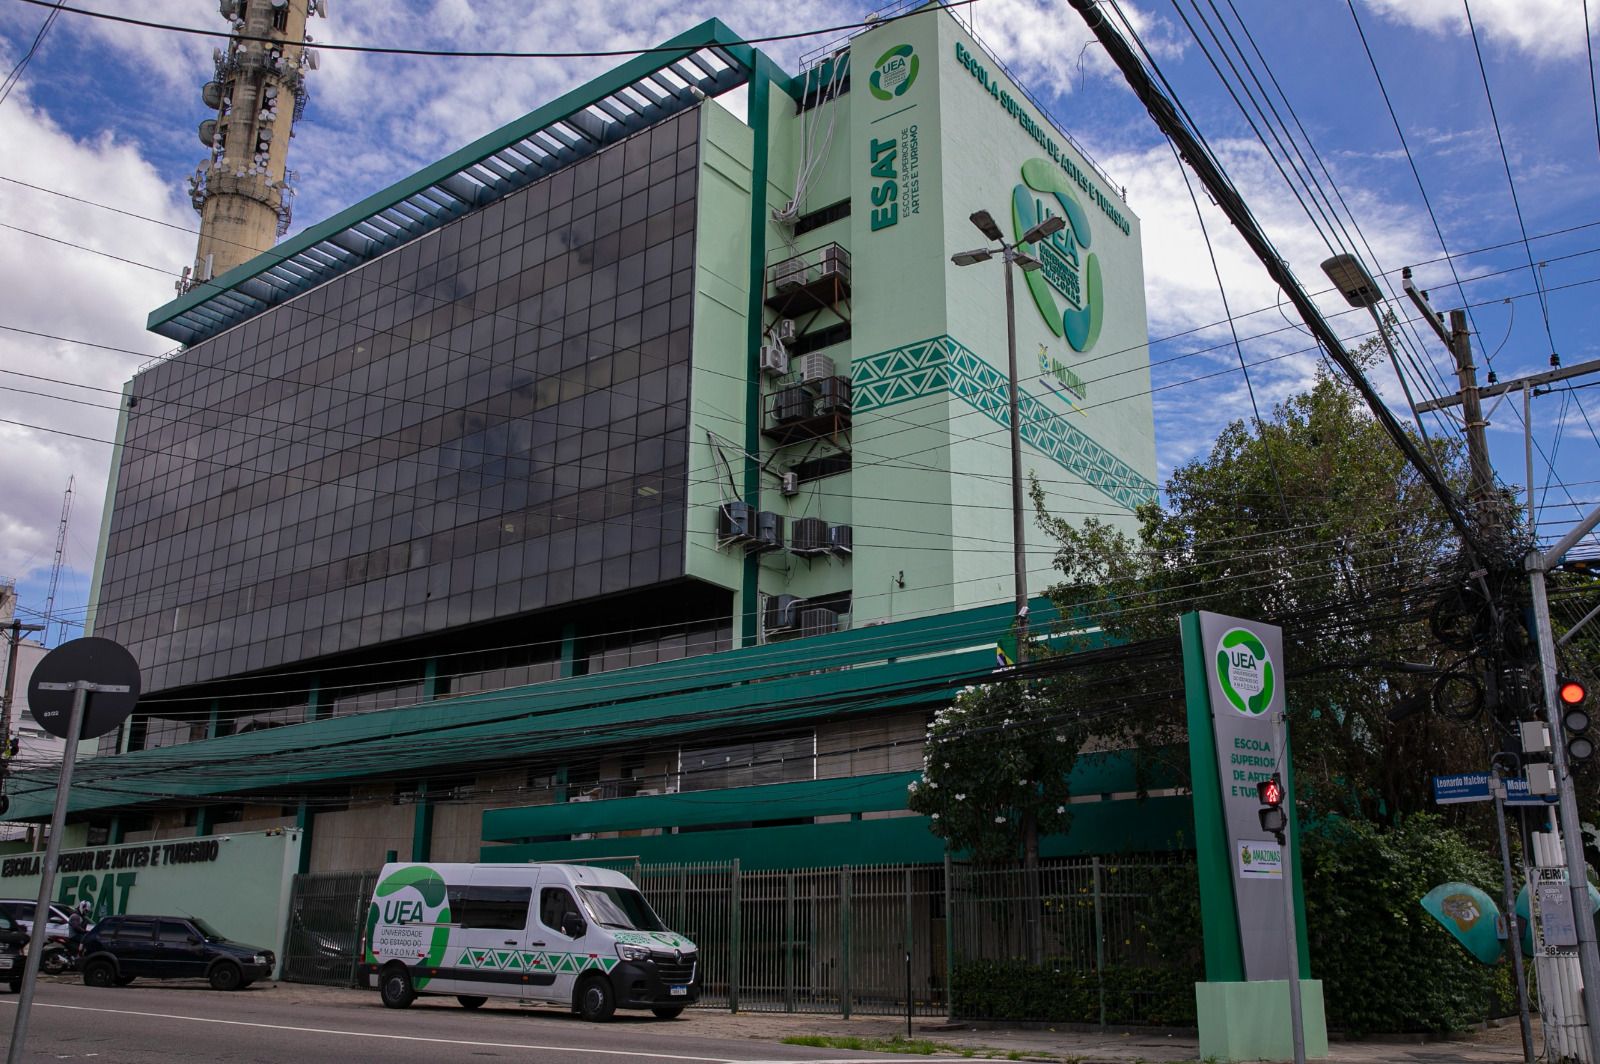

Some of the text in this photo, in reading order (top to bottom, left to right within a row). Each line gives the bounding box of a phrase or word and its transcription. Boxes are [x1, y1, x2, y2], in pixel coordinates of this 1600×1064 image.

[882, 57, 905, 74] UEA
[901, 127, 908, 140] DE
[956, 42, 1130, 236] ESCOLA SUPERIOR DE ARTES E TURISMO
[909, 125, 920, 214] ARTES E TURISMO
[870, 138, 898, 231] ESAT
[1231, 651, 1256, 670] UEA
[1234, 738, 1271, 752] ESCOLA
[1233, 770, 1271, 782] DE ARTE
[1436, 775, 1487, 788] Leonardo Malcher
[1232, 785, 1258, 798] E TUR
[1, 839, 219, 878] ESCOLA PERIOR DE ARTES E TURISMO
[58, 872, 137, 924] ESAT
[384, 900, 423, 924] UEA
[381, 929, 423, 938] UNIVERSIDADE
[389, 938, 412, 947] ESTADO
